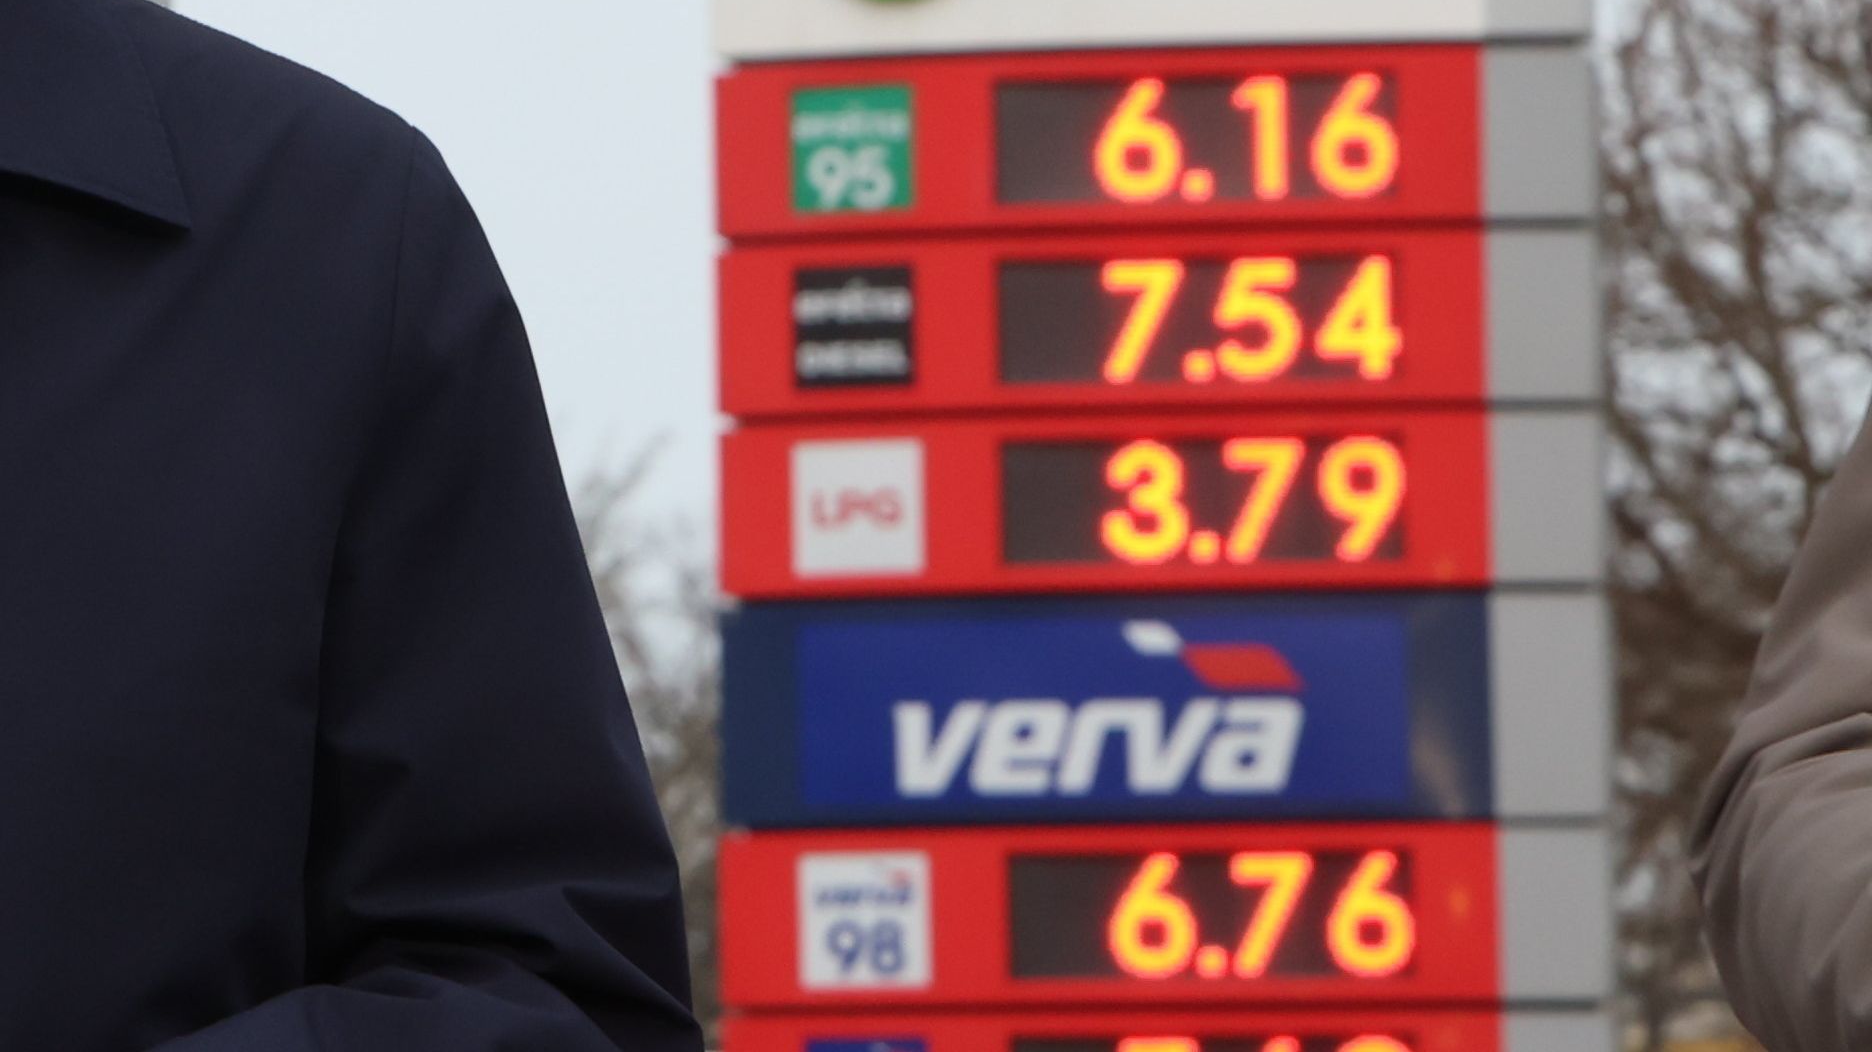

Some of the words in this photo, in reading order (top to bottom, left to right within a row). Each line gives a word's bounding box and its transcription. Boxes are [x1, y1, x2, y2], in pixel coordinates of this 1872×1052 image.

[807, 145, 895, 212] 95
[1094, 72, 1400, 203] 6.16
[1100, 253, 1403, 385] 7.54
[810, 486, 904, 532] LPG
[1101, 435, 1407, 565] 3.79
[892, 696, 1305, 798] verva
[825, 919, 905, 977] 98
[1109, 849, 1416, 980] 6.76
